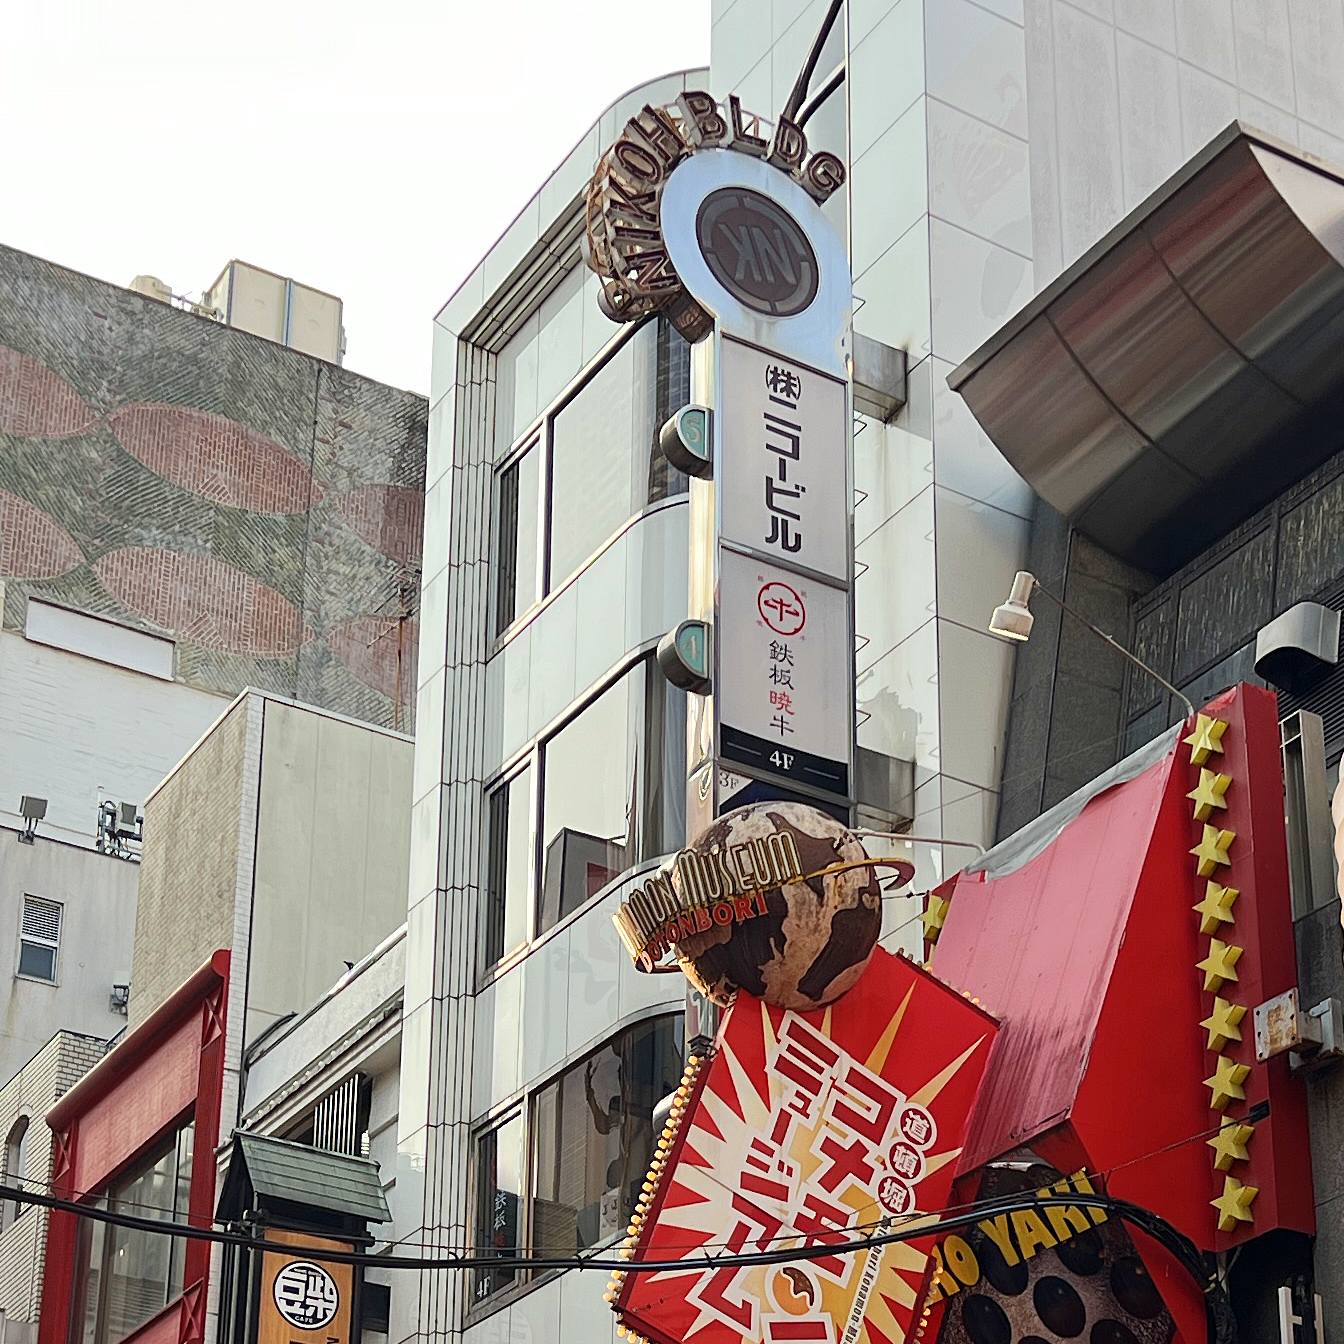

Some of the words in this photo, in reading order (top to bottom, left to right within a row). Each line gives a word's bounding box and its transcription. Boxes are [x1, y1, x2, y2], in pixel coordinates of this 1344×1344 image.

[768, 750, 795, 770] 4F
[677, 830, 803, 907] MUSEUM
[877, 1107, 929, 1215] 道頓堀
